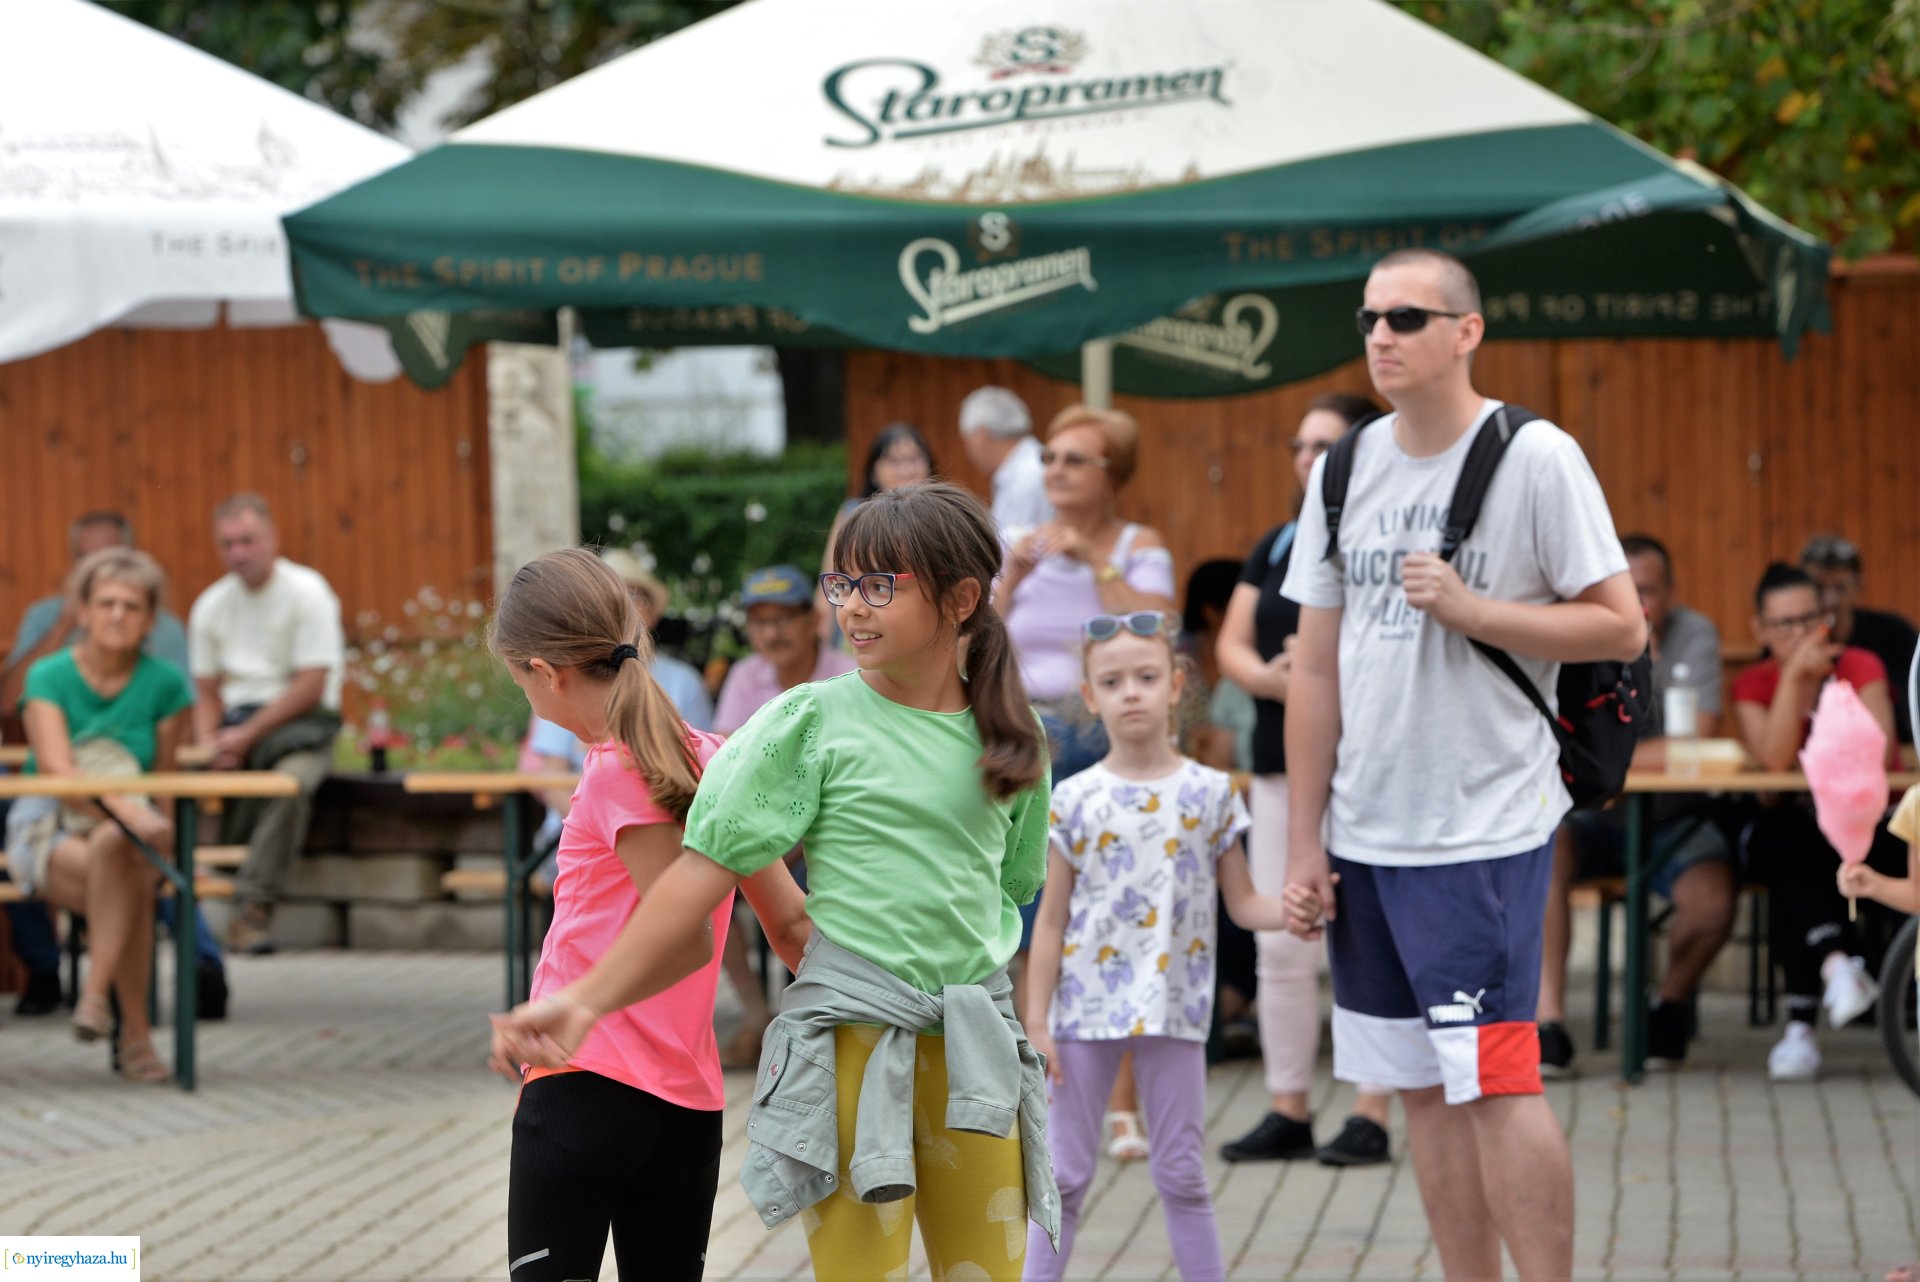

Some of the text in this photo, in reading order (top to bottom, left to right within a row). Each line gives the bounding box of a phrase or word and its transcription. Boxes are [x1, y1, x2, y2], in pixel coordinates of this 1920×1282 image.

[822, 58, 1232, 148] Staropramen
[617, 252, 765, 283] PRAGUE
[1225, 232, 1295, 262] THE
[898, 237, 1098, 334] Staropramen
